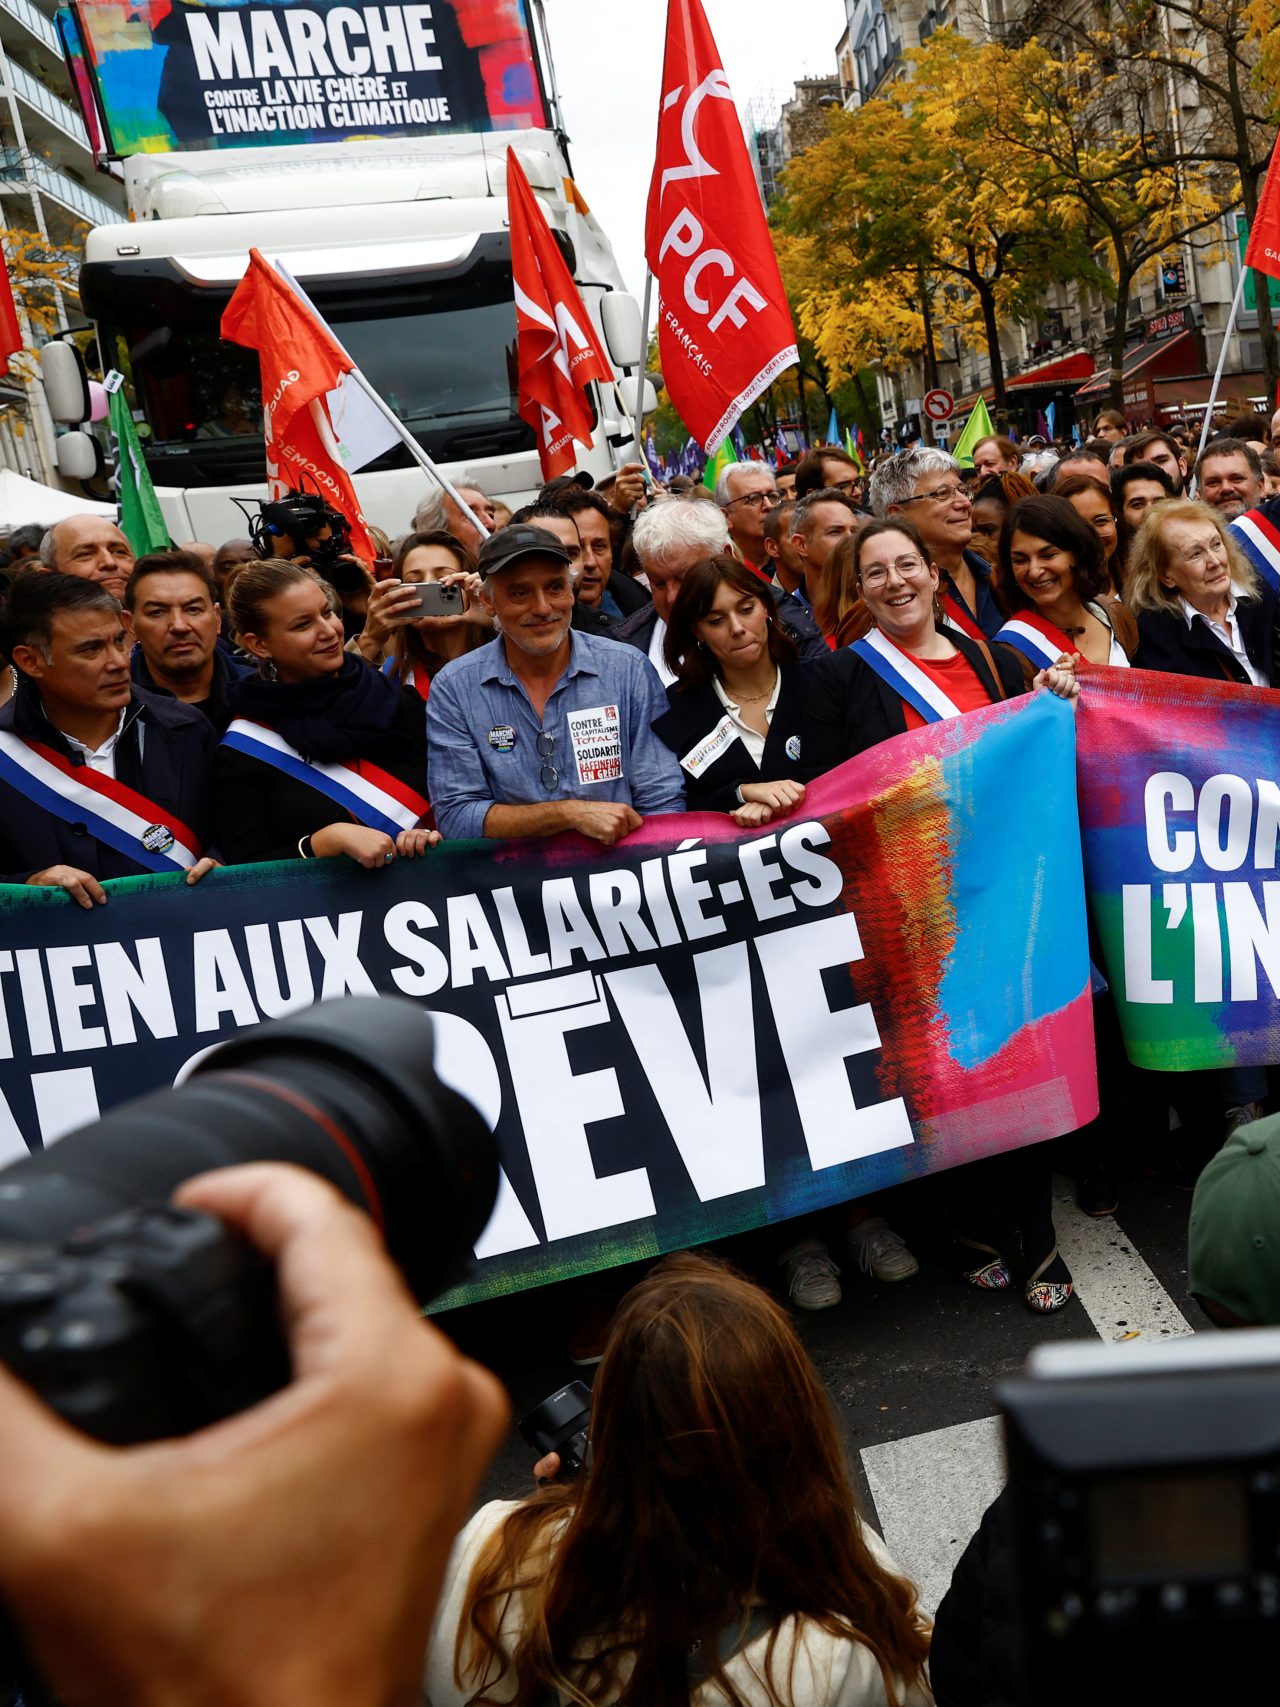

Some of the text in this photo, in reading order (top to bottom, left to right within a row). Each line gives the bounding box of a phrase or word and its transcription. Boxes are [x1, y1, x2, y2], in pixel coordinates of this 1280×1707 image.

[185, 4, 443, 80] MARCHE
[203, 73, 408, 108] CONTRE LA VIE CHÈRE ET
[208, 97, 451, 134] L'INACTION CLIMATIQUE
[659, 207, 768, 333] PCF
[665, 311, 713, 377] FRANÇAIS
[706, 429, 721, 452] FABIEN
[720, 400, 742, 429] ROUSSEL
[742, 385, 756, 401] 2022
[757, 373, 766, 383] LE
[765, 359, 780, 375] DÉFI
[779, 349, 794, 361] DES
[571, 718, 603, 731] CONTRE
[574, 735, 612, 745] TOTAL
[581, 726, 618, 737] CAPITALISME
[577, 743, 620, 760] SOLIDARITÉ
[582, 767, 620, 781] EN GRÈVE
[193, 911, 380, 1033] AUX
